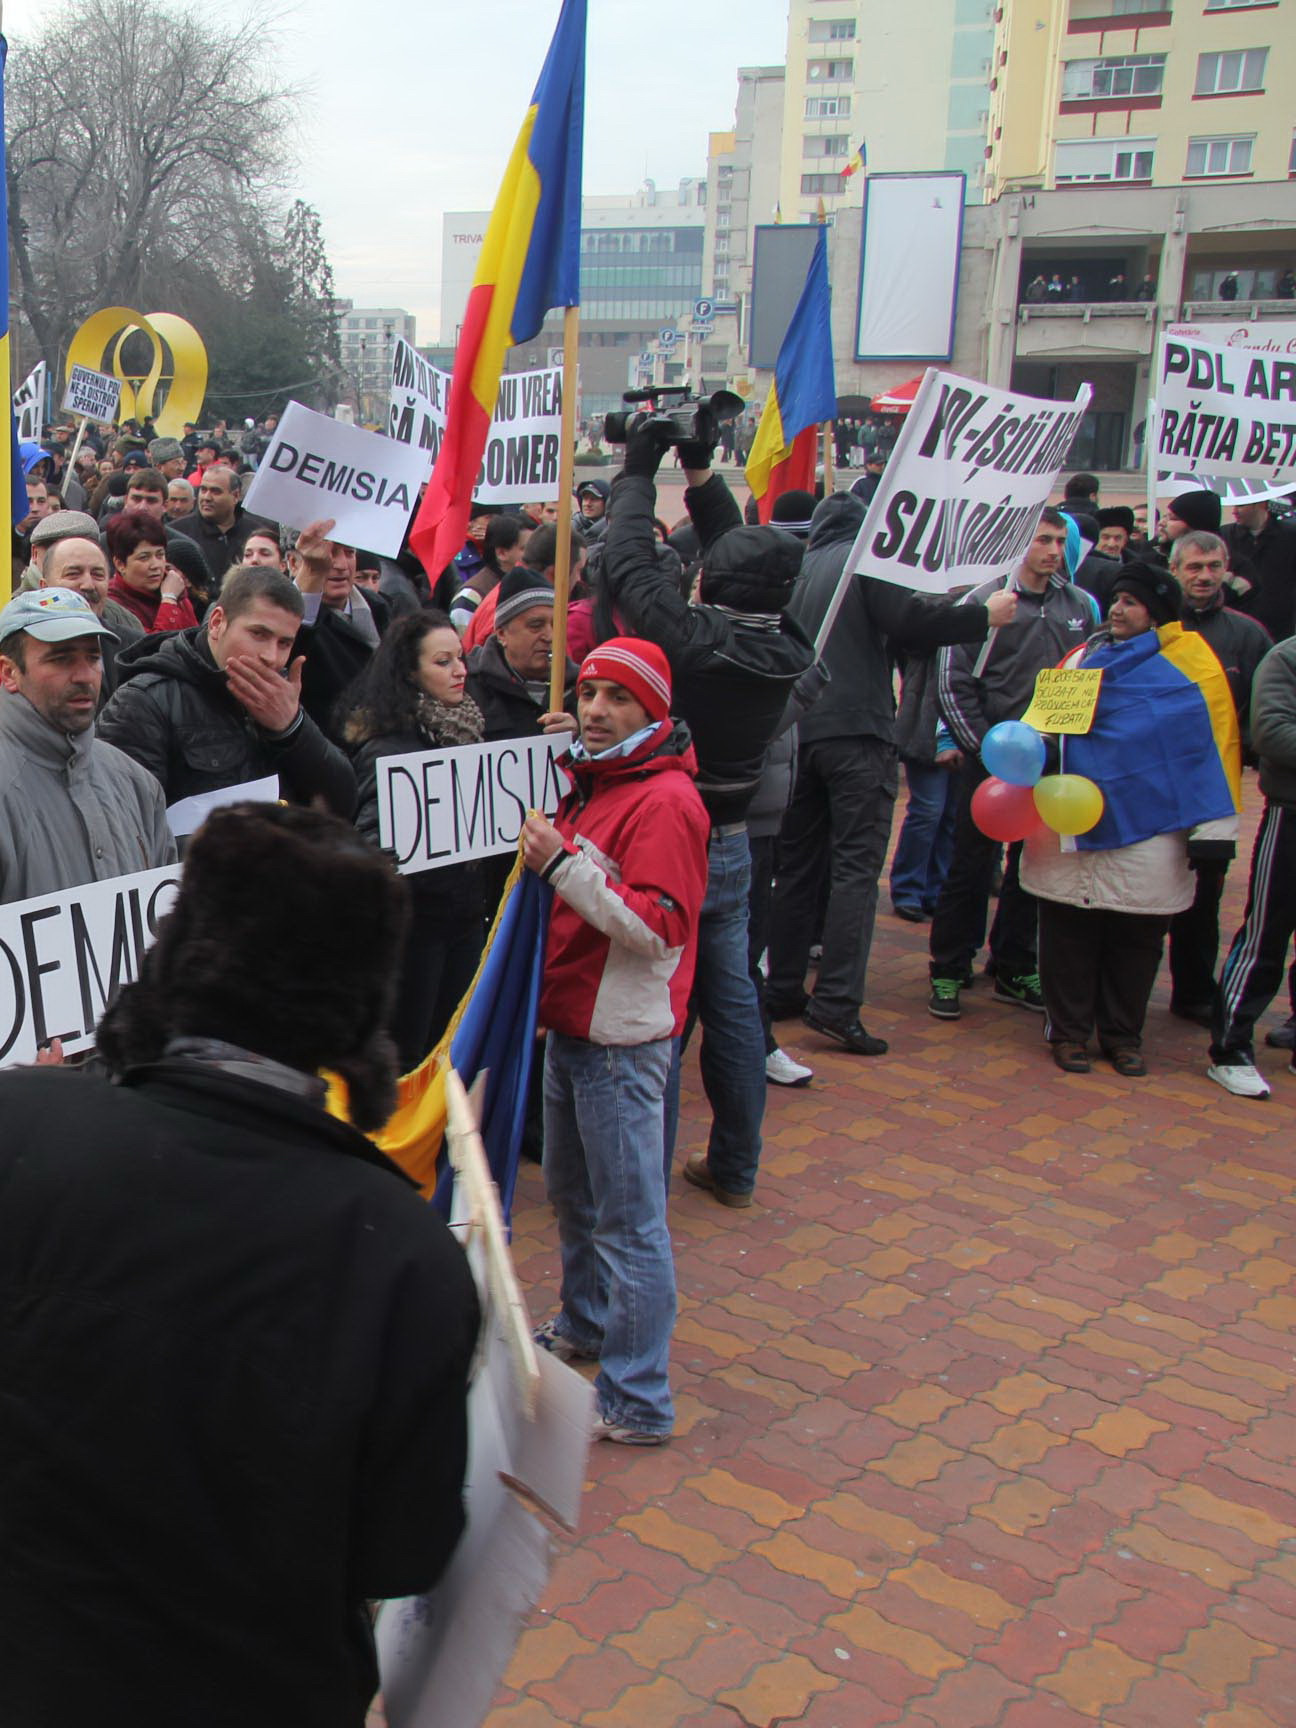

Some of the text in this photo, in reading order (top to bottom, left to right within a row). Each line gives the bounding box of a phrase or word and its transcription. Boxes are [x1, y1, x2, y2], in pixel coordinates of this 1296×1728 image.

[71, 368, 122, 396] GUVERNUL PDL
[87, 389, 117, 408] DISTRUS
[392, 340, 416, 388] AM
[415, 354, 428, 404] 20
[428, 366, 442, 412] DE
[494, 382, 518, 423] NU
[1164, 342, 1235, 395] PDL
[389, 395, 417, 446] SĂ
[1158, 400, 1240, 471] RĂȚIA
[268, 441, 410, 512] DEMISIA
[387, 744, 563, 866] DEMISIA
